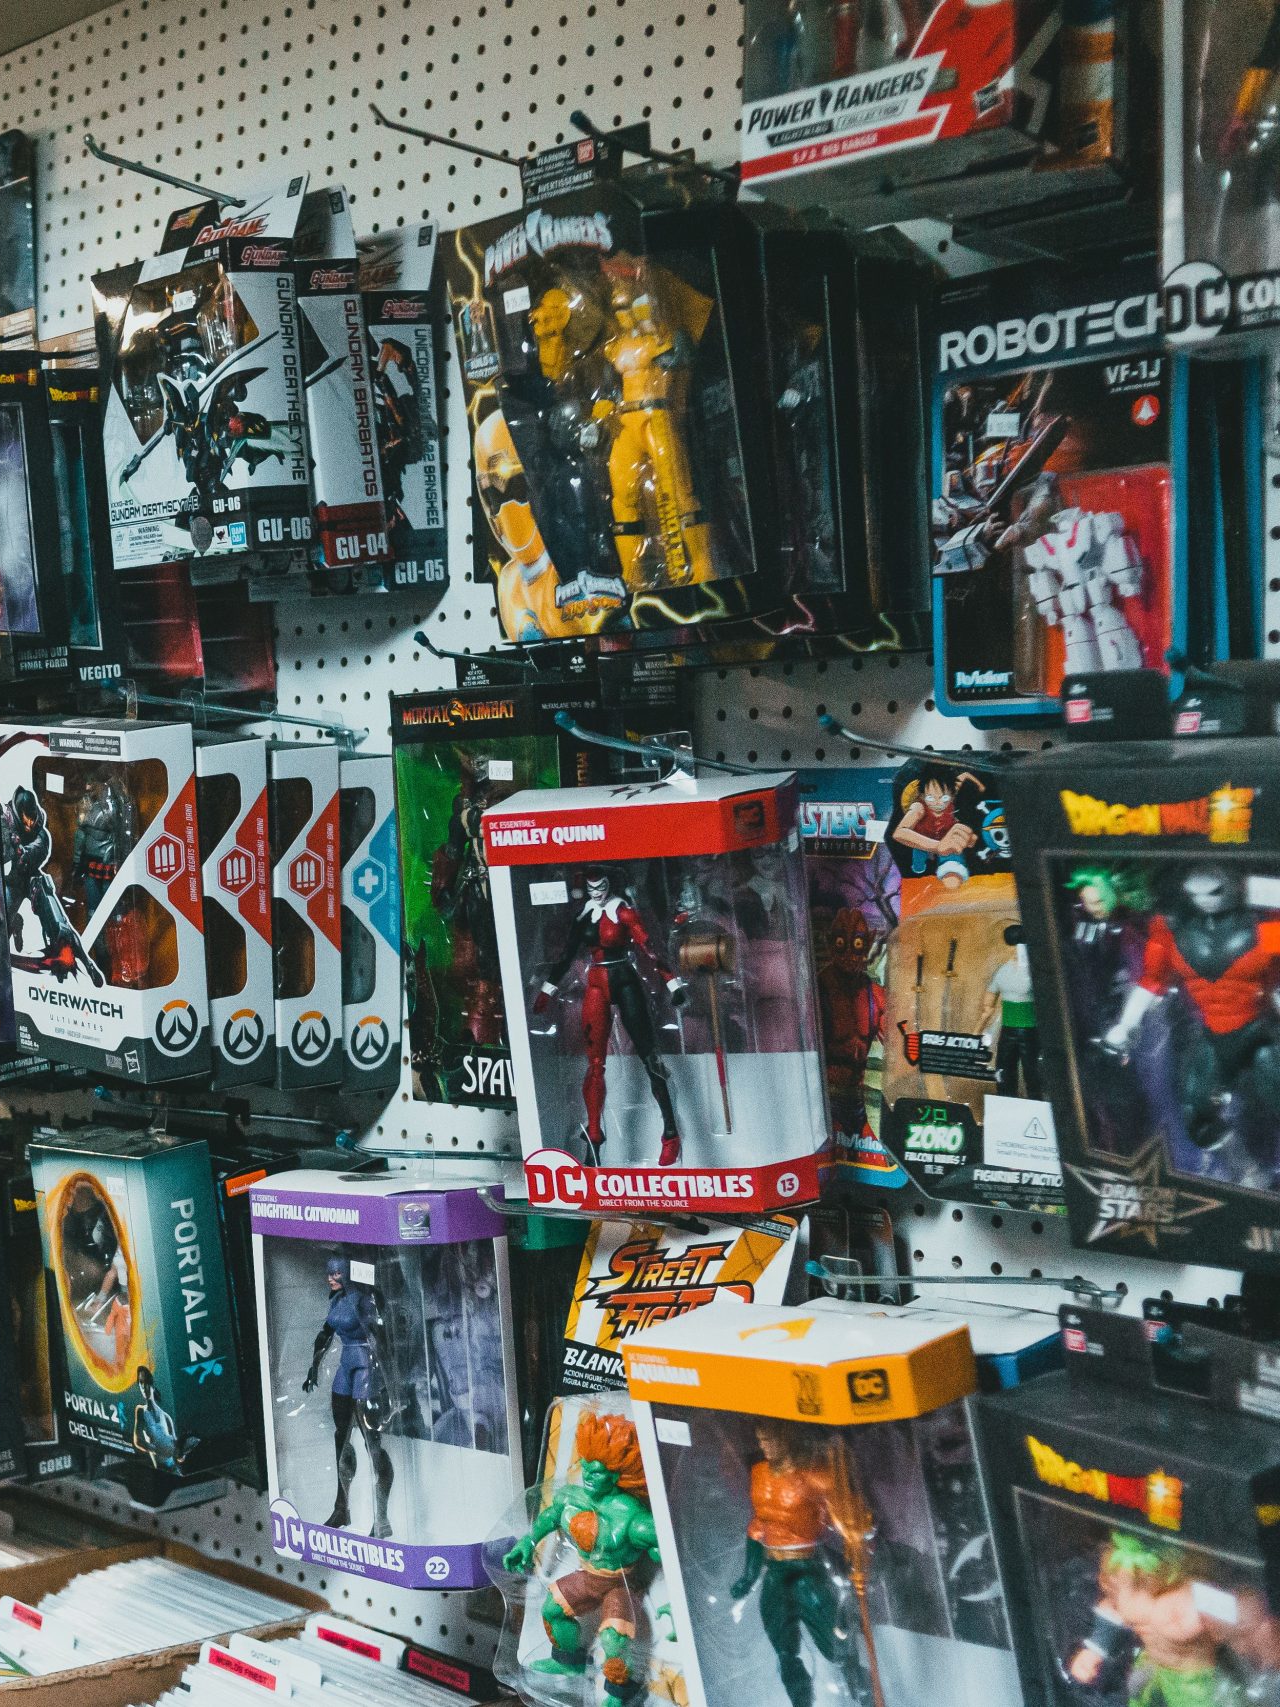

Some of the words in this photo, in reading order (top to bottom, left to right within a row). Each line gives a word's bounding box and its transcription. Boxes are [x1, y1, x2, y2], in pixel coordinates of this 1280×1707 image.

[748, 98, 816, 134] POWER
[833, 67, 930, 112] RANGERS
[240, 245, 287, 265] GUNDAM
[276, 276, 296, 350] GUNDAM
[1164, 277, 1231, 333] DC
[343, 299, 366, 383] GUNDAM
[939, 292, 1165, 372] ROBOTECH
[1106, 357, 1162, 385] VF-1J
[283, 352, 307, 482] DEATHSCYTHE
[352, 384, 379, 498] BARBATOS
[110, 508, 141, 523] GUNDAM
[142, 494, 201, 518] DEATHSCYTHE
[213, 496, 242, 514] GU-06
[422, 464, 440, 527] BANSHEE
[257, 516, 312, 543] GU-06
[334, 531, 389, 561] GU-04
[394, 558, 445, 585] GU-05
[79, 663, 122, 682] VEGITO
[402, 705, 450, 726] MORTAL
[463, 699, 515, 722] KOMBAT
[499, 819, 536, 829] ESSENTIALS
[800, 802, 876, 838] STERS
[490, 826, 549, 848] HARLEY
[551, 824, 606, 845] QUINN
[189, 877, 198, 903] DAMAGE
[28, 985, 124, 1020] OVERWATCH
[49, 1014, 105, 1033] ULTIMATES
[947, 1035, 981, 1050] ACTION
[462, 1055, 517, 1098] SPA
[907, 1124, 964, 1152] ZORO
[524, 1163, 588, 1209] DC
[594, 1173, 755, 1199] COLLECTIBLES
[779, 1177, 797, 1193] 13
[973, 1169, 1021, 1185] FIGURINE
[1023, 1171, 1064, 1188] D'ACTIO
[252, 1202, 304, 1220] KNIGHTFALL
[304, 1206, 360, 1225] CATWOMAN
[598, 1198, 622, 1208] DIRECT
[623, 1199, 645, 1208] FROM
[646, 1200, 660, 1208] THE
[660, 1200, 689, 1209] SOURCE
[1098, 1199, 1177, 1222] STARS
[170, 1197, 209, 1335] PORTAL
[599, 1241, 726, 1289] STREET
[188, 1336, 214, 1362] 2
[563, 1347, 626, 1378] BLANK
[562, 1378, 582, 1388] FIGURA
[563, 1369, 584, 1380] ACTION
[630, 1362, 701, 1387] AQUAMAN
[64, 1390, 109, 1420] PORTAL
[109, 1407, 120, 1423] 2
[68, 1420, 99, 1442] CHELL
[38, 1456, 72, 1476] GOKU
[270, 1510, 306, 1556] DC
[308, 1528, 405, 1573] COLLECTIBLES
[326, 1556, 339, 1567] FROM
[339, 1560, 348, 1569] THE
[348, 1562, 365, 1573] SOURCE
[428, 1561, 447, 1575] 22
